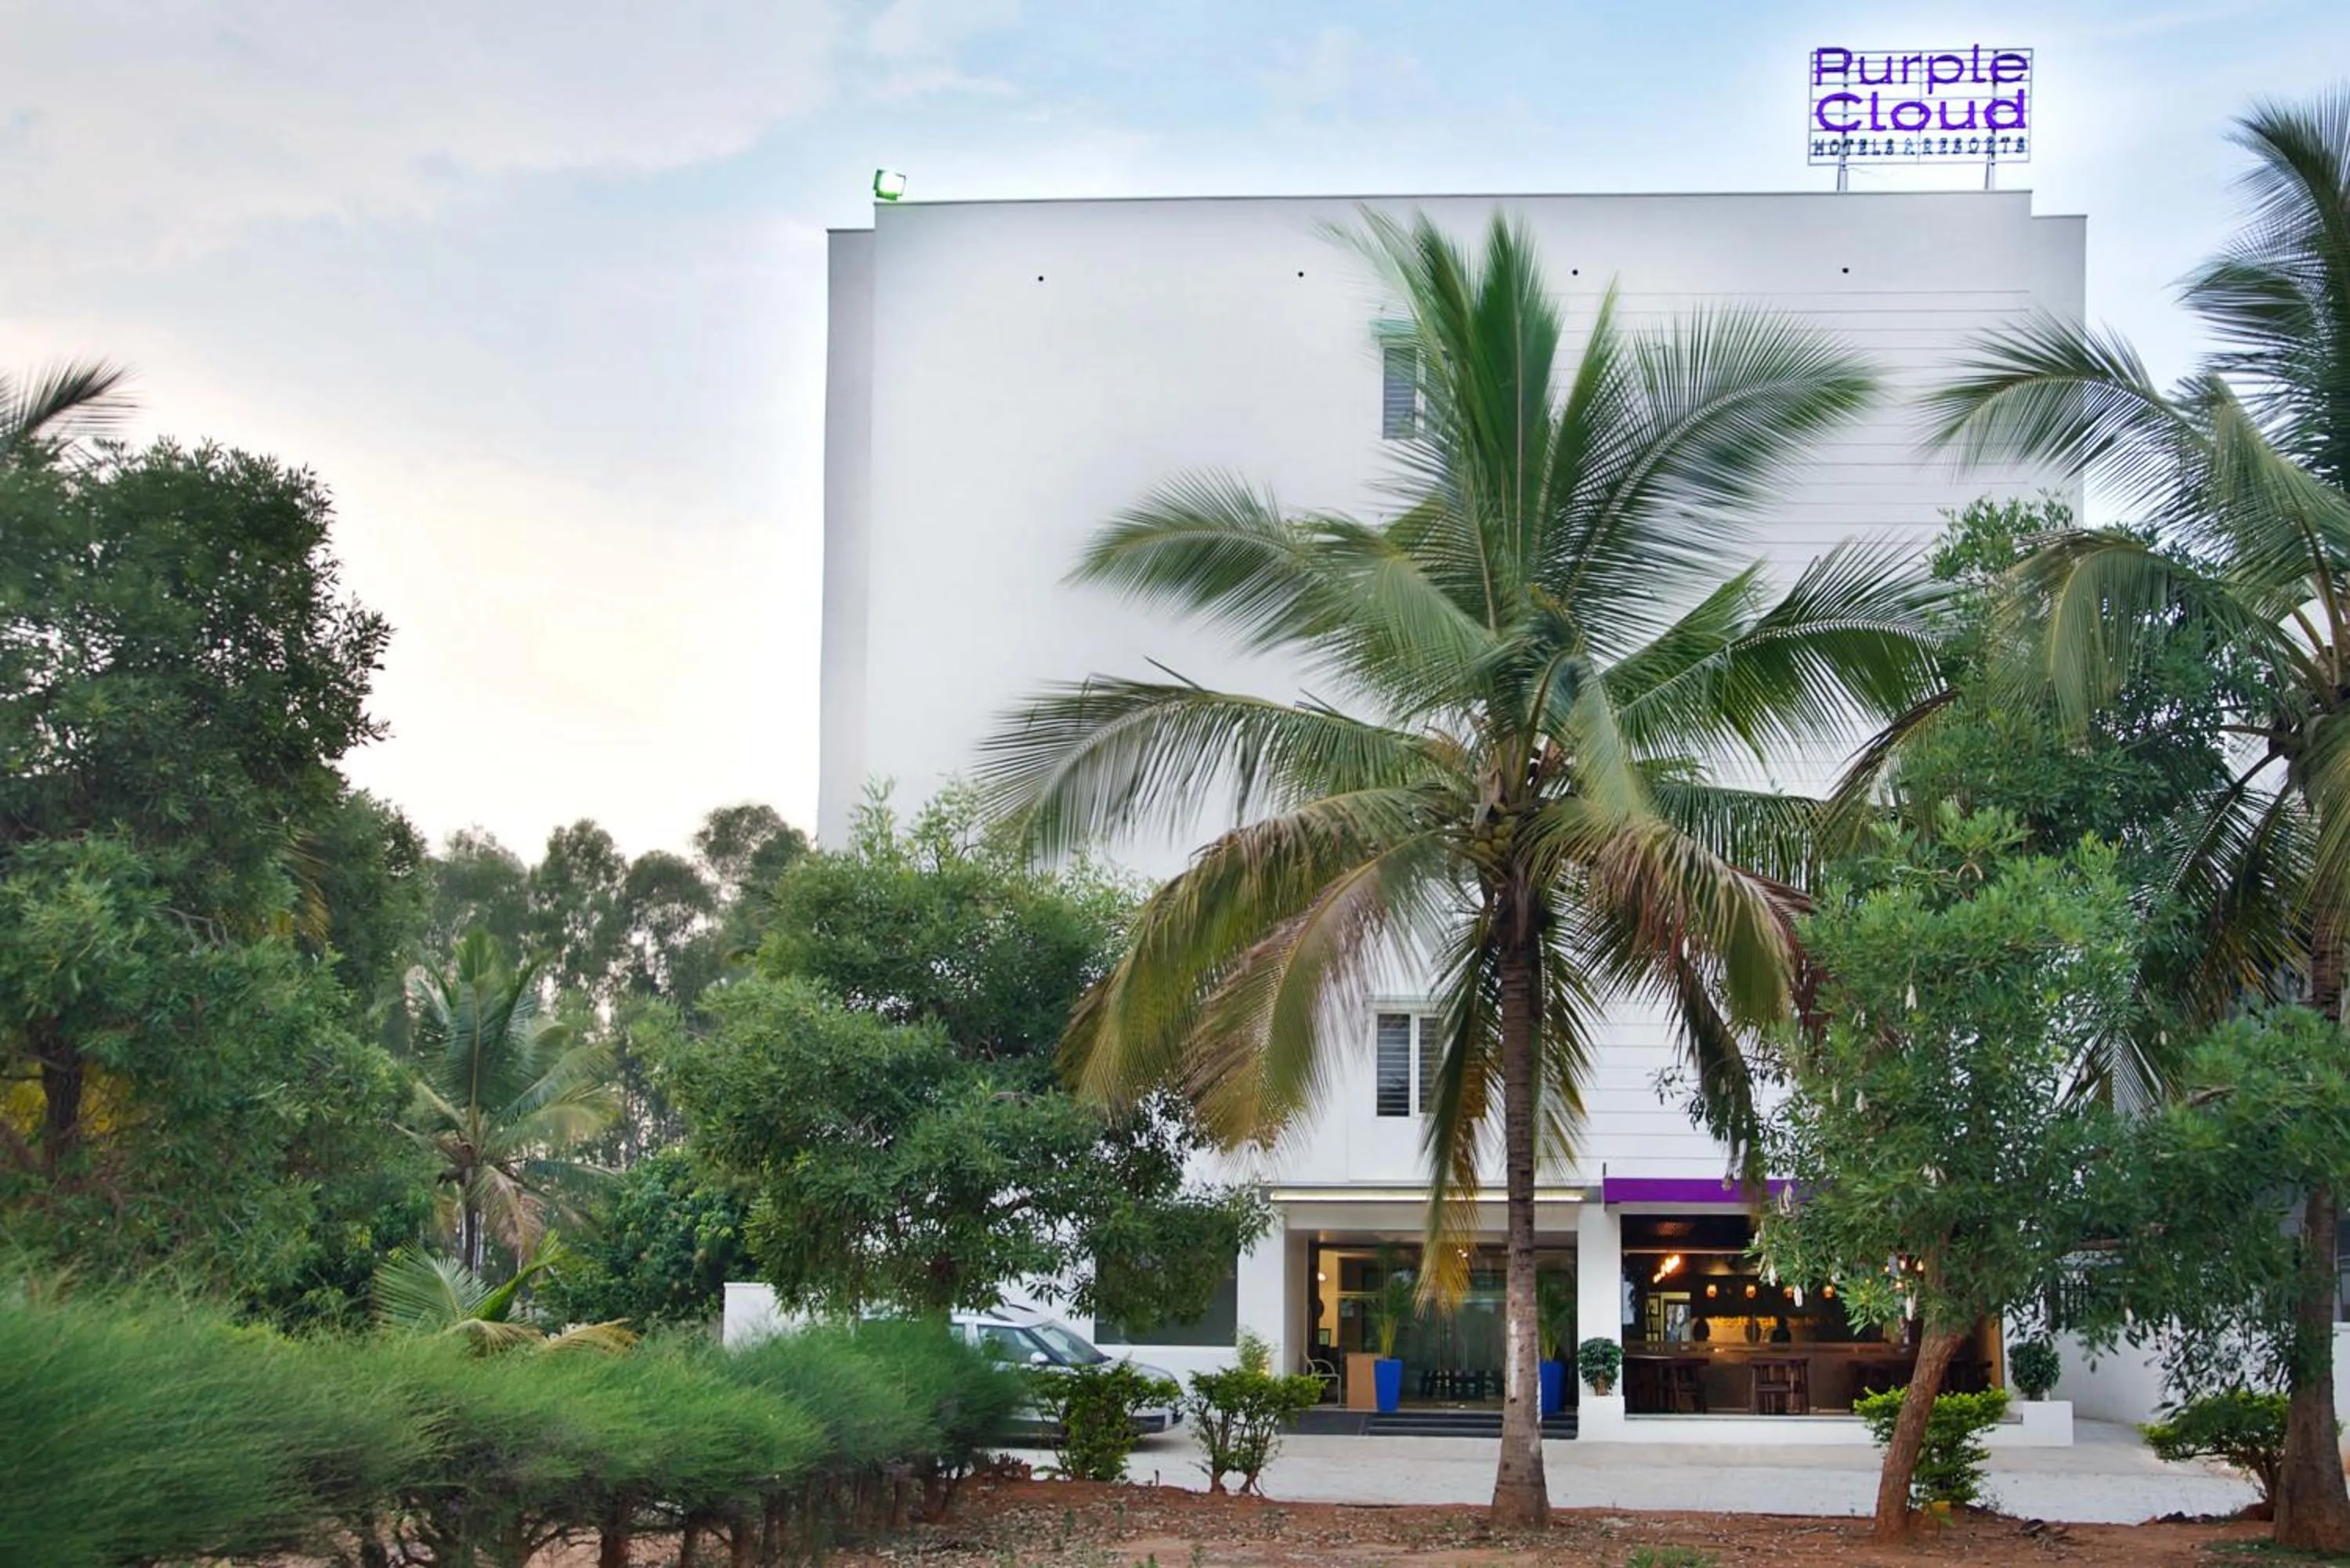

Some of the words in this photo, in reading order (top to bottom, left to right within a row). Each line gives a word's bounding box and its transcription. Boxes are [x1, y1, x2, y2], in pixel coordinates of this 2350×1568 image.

[1816, 44, 2028, 94] Purple
[1817, 89, 2026, 132] Cloud
[1813, 138, 1894, 155] HOTELS
[1923, 136, 2026, 155] RESORTS
